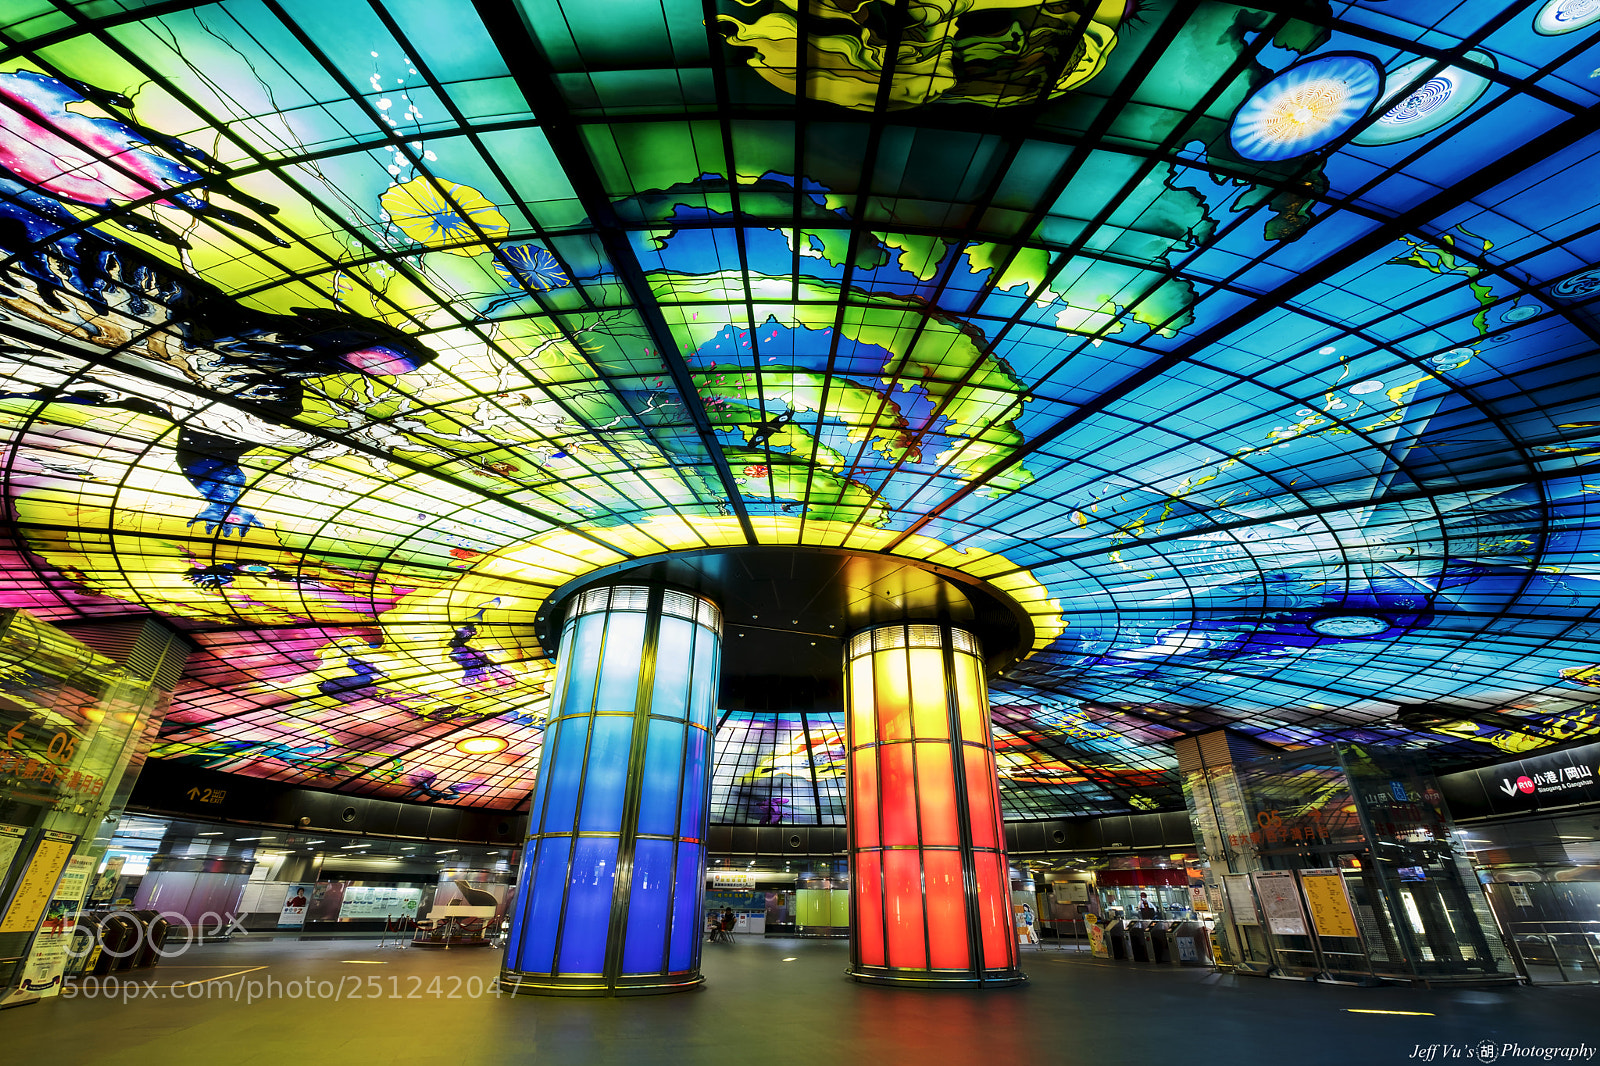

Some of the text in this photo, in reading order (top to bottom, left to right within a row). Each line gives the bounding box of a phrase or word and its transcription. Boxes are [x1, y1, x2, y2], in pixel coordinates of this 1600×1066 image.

[1518, 765, 1592, 790] R10 小港/岡山
[1566, 779, 1594, 788] Gangshan
[200, 788, 211, 802] 2
